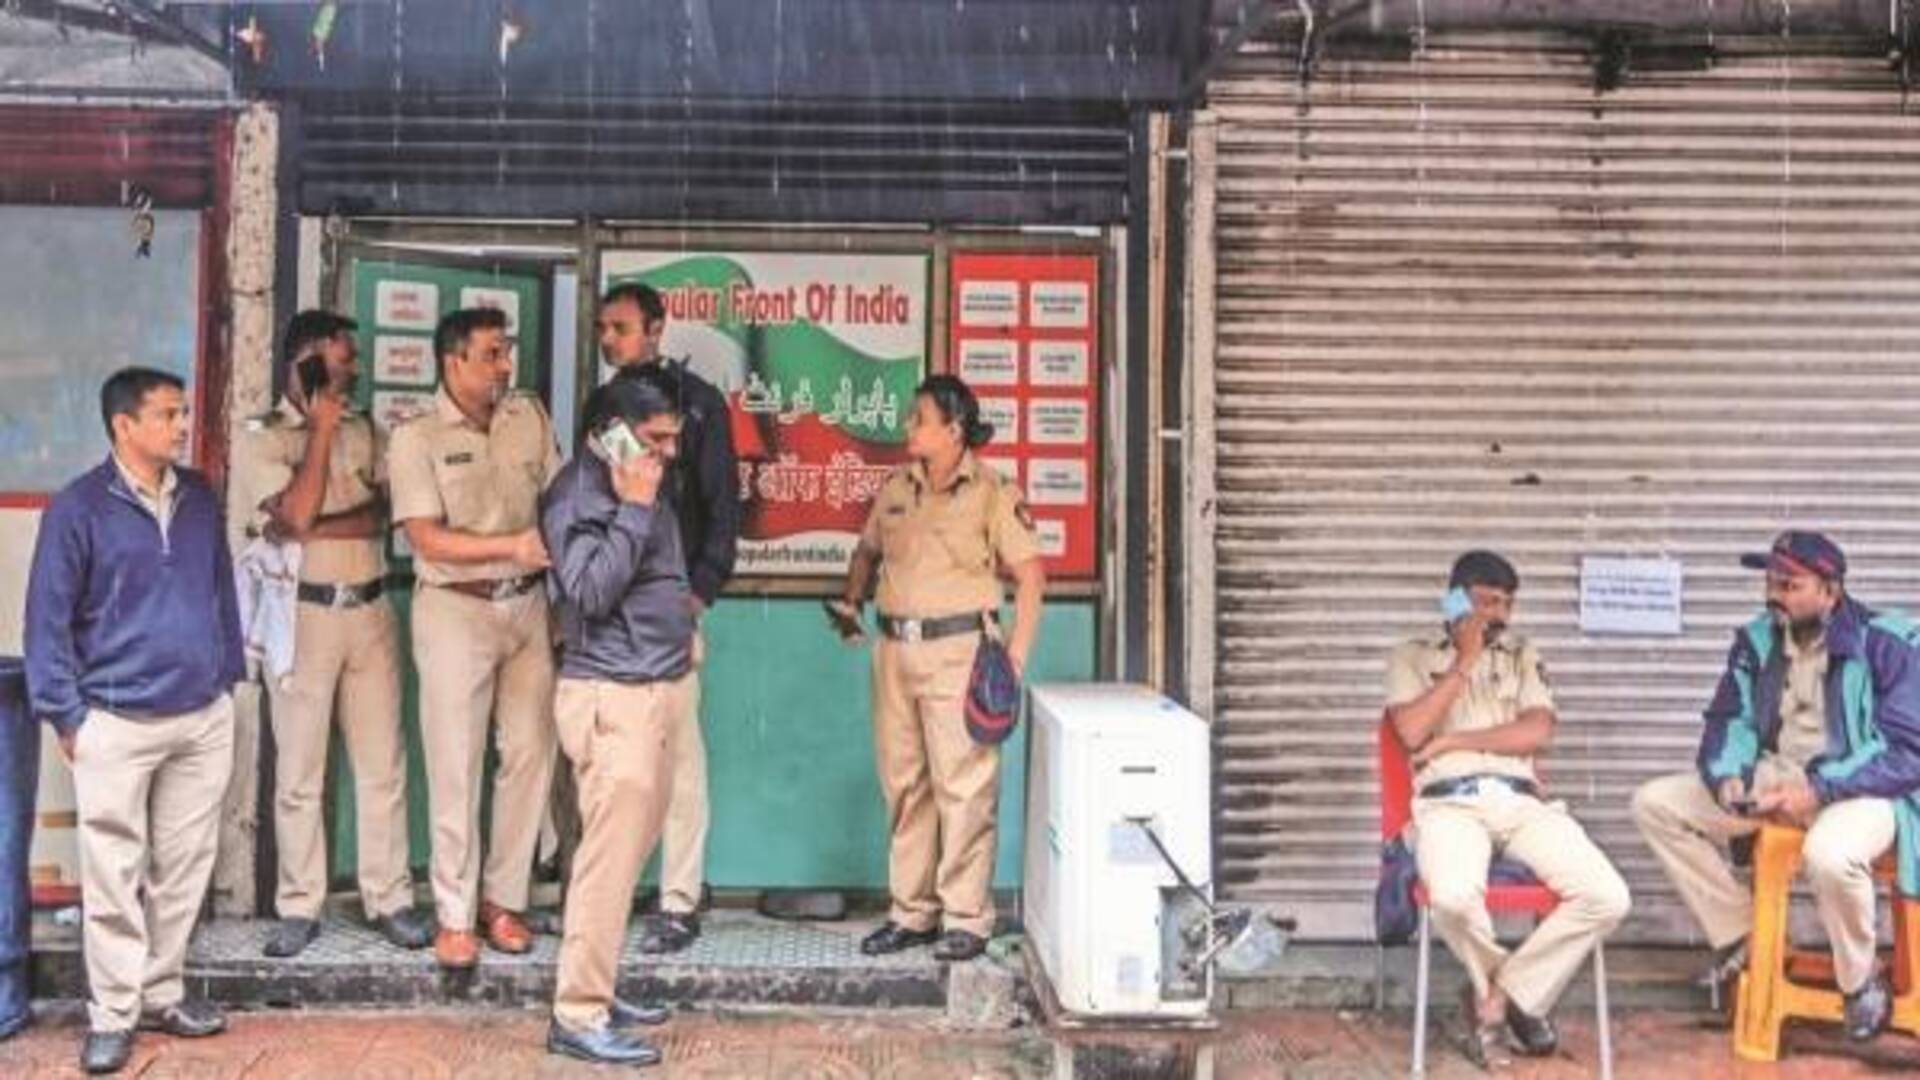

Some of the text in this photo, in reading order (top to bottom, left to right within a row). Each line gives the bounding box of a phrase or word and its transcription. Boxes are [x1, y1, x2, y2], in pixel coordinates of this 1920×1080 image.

[733, 284, 795, 321] Front
[808, 283, 834, 321] Of
[848, 285, 908, 323] India
